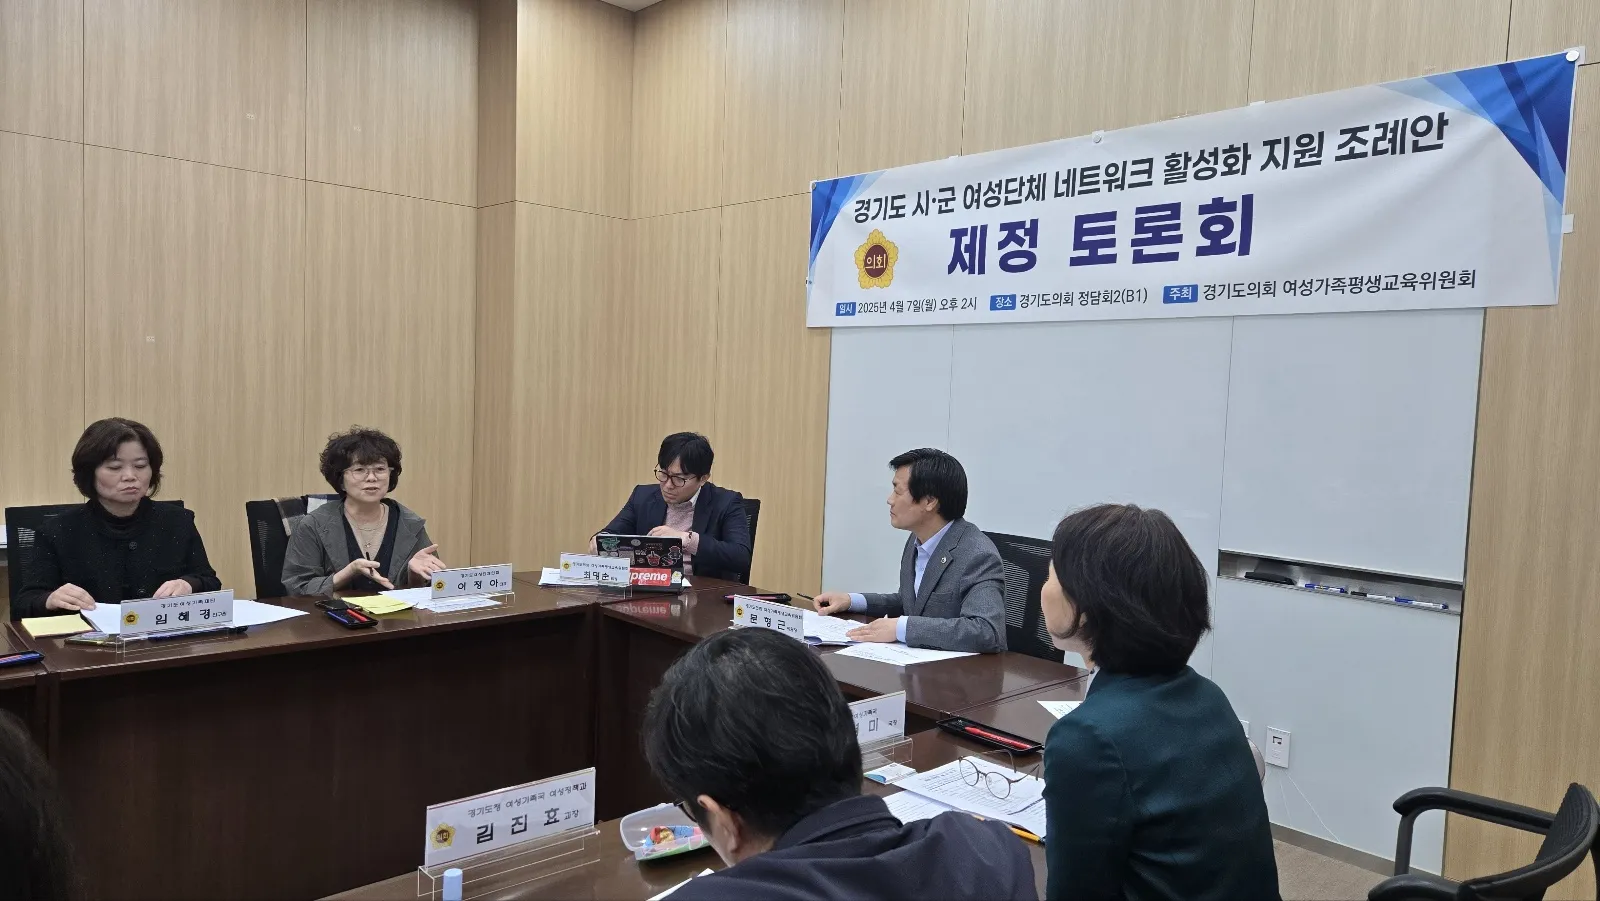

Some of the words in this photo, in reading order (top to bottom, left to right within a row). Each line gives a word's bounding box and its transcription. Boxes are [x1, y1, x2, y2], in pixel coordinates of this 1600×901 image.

[854, 194, 906, 223] 경기도
[912, 186, 956, 217] 시·군
[963, 172, 1047, 210] 여성단체
[1053, 157, 1154, 198] 네트워크
[1163, 142, 1252, 185] 활성화
[1260, 130, 1325, 171] 지원
[1334, 111, 1449, 162] 조례안
[947, 218, 1039, 275] 제정
[1069, 193, 1254, 267] 토론회
[865, 253, 887, 269] 의회
[839, 303, 853, 314] 일시
[857, 301, 887, 314] 2025년
[889, 300, 904, 313] 4월
[906, 298, 937, 313] 7일(월)
[939, 297, 959, 311] 오후
[961, 296, 978, 311] 2시
[995, 296, 1013, 309] 장소
[1019, 291, 1074, 309] 경기도의회
[1078, 287, 1148, 306] 정담회2(B1)
[1169, 286, 1192, 301] 주최
[1203, 280, 1277, 301] 경기도의회
[1283, 269, 1476, 297] 여성가족평생교육위원회
[629, 572, 668, 583] preme
[467, 803, 501, 818] 경기도청
[505, 792, 545, 808] 여성가족국
[549, 782, 587, 798] 여성정책과
[476, 807, 560, 845] 김진효
[563, 809, 580, 821] 과장
